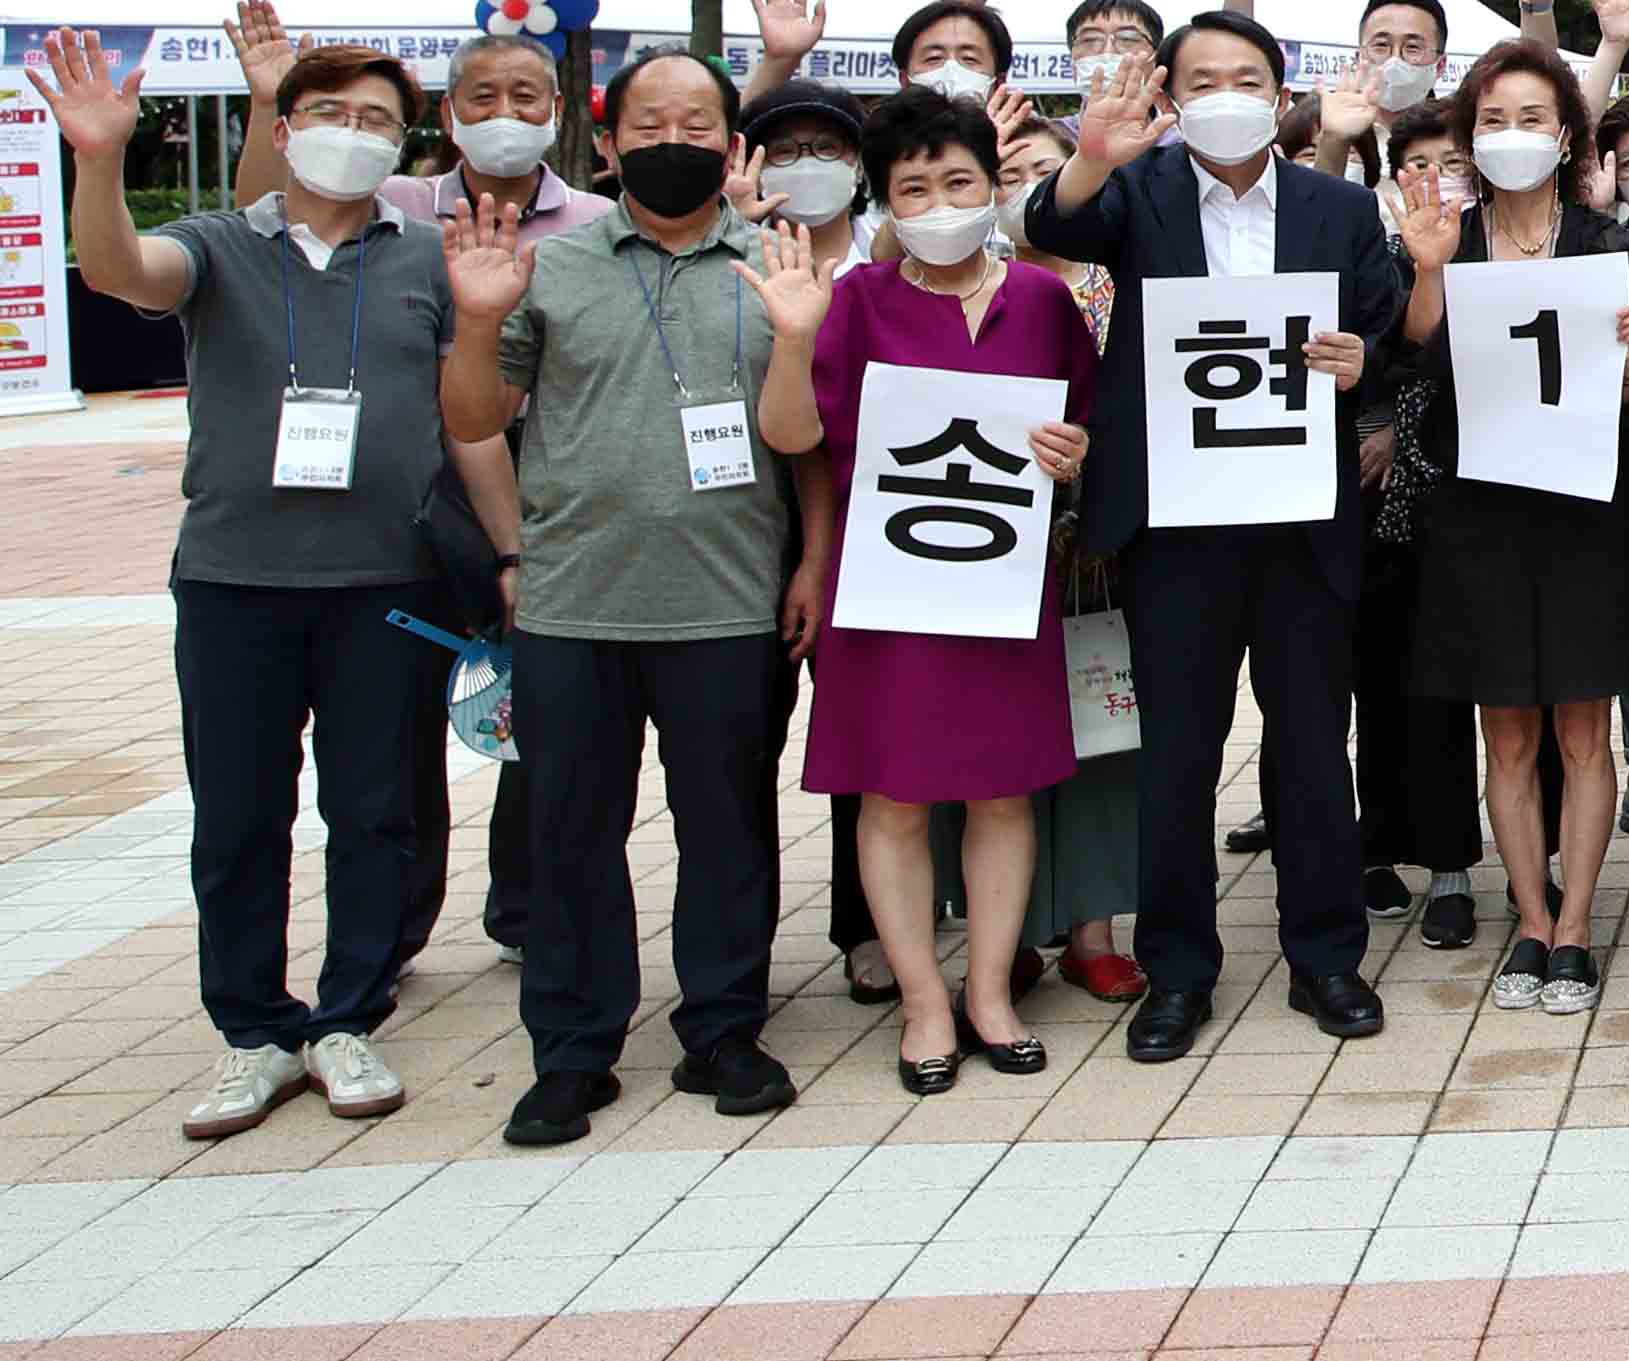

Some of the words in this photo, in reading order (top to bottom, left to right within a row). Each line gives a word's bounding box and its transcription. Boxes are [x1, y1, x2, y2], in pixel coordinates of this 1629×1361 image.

[160, 36, 239, 60] 송현1.
[399, 37, 459, 59] 운영부
[1011, 53, 1073, 79] 현1.2동
[1174, 315, 1310, 449] 현
[1509, 309, 1562, 406] 1
[689, 424, 744, 443] 진행요원
[877, 417, 1034, 562] 송
